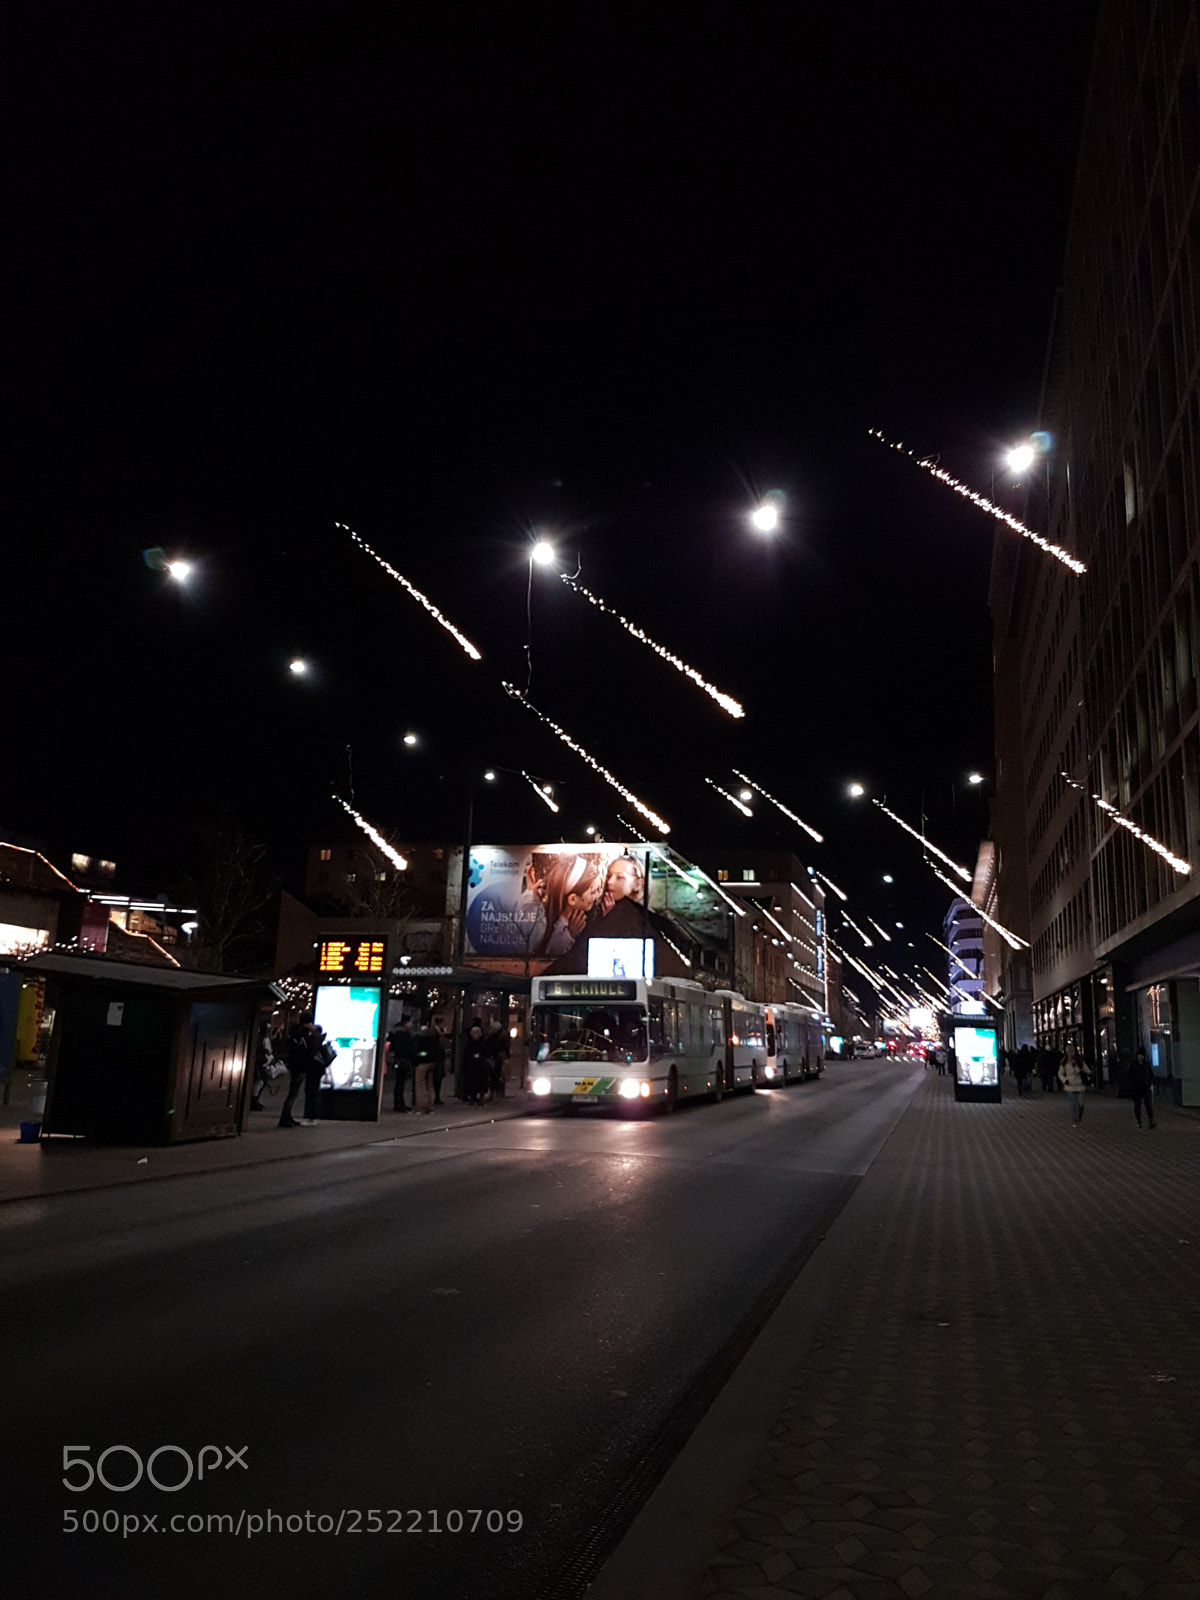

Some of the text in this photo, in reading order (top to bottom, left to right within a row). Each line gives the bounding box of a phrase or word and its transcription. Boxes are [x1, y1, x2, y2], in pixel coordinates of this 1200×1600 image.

[490, 860, 520, 868] Telekom
[481, 900, 494, 911] ZA
[554, 982, 562, 995] 6
